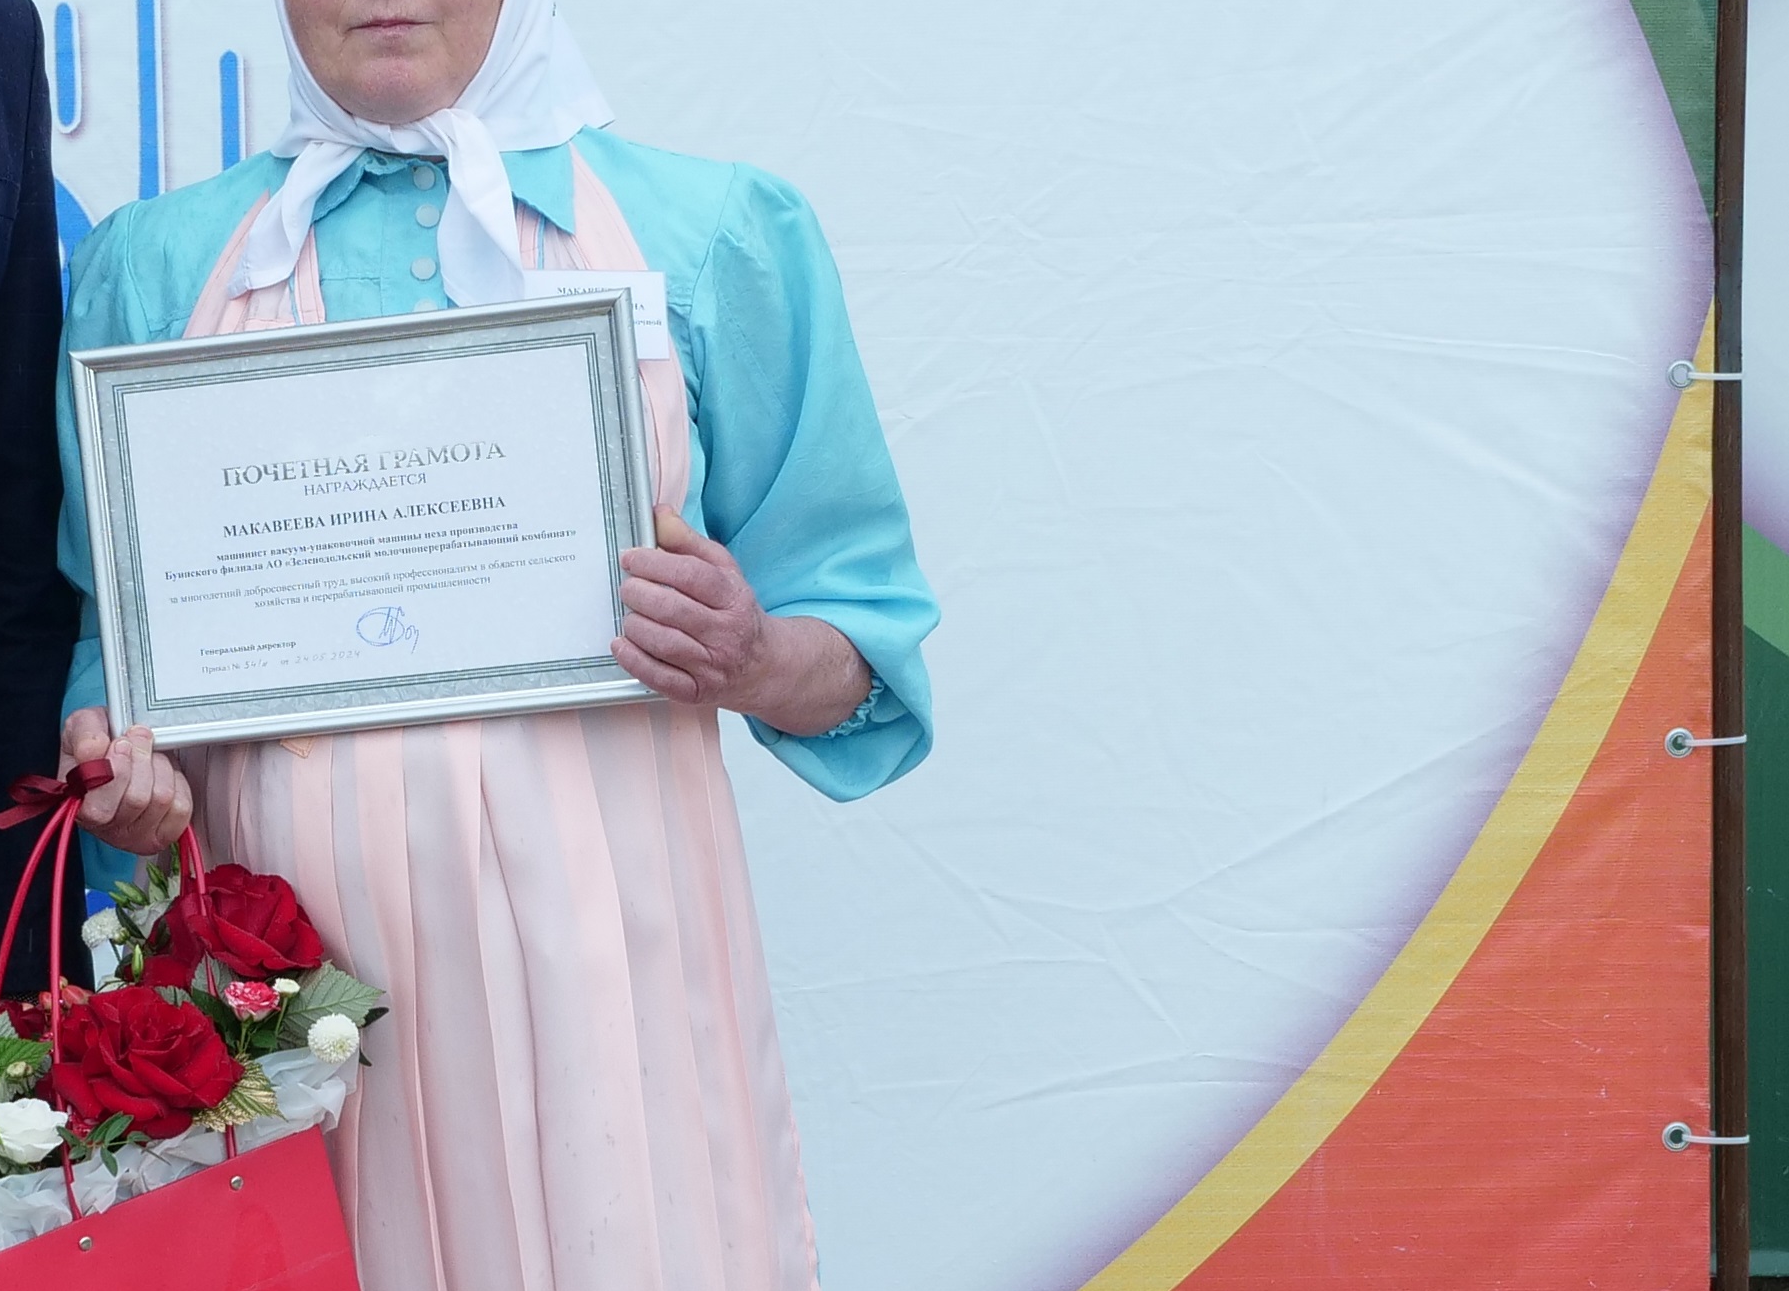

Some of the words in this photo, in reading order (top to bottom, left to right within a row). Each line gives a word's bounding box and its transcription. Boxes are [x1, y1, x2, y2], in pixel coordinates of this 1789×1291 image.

[221, 453, 370, 487] ПОЧЕТНАЯ
[378, 440, 507, 471] ГРАМОТА
[303, 472, 427, 497] НАГРАЖДАЕТСЯ
[222, 515, 326, 539] МАКАВЕЕВА
[330, 509, 388, 527] ИРИНА
[392, 496, 507, 520] АЛЕКСЕЕВНА
[164, 568, 218, 582] Буинского
[219, 563, 264, 577] филиала
[265, 559, 283, 570] АО
[284, 549, 372, 567] «Зеленодольский
[374, 533, 519, 558] молочноперерабатывающий
[521, 529, 577, 542] комбинат»
[216, 550, 267, 562] машинист
[270, 536, 376, 557] вакуум-упаковочной
[377, 533, 422, 544] машины
[424, 530, 448, 539] цеха
[449, 523, 519, 539] производства
[180, 588, 242, 603] многолетний
[243, 579, 321, 598] добросовестный
[323, 578, 349, 590] труд,
[349, 571, 391, 585] высокий
[392, 564, 478, 582] профессионализм
[480, 563, 486, 571] в
[487, 559, 526, 570] области
[527, 554, 576, 566] сельского
[254, 596, 301, 609] хозяйства
[303, 595, 310, 604] и
[311, 584, 404, 603] перерабатывающей
[406, 576, 491, 594] промышленности
[199, 643, 256, 657] Генеральный
[256, 641, 297, 653] директор
